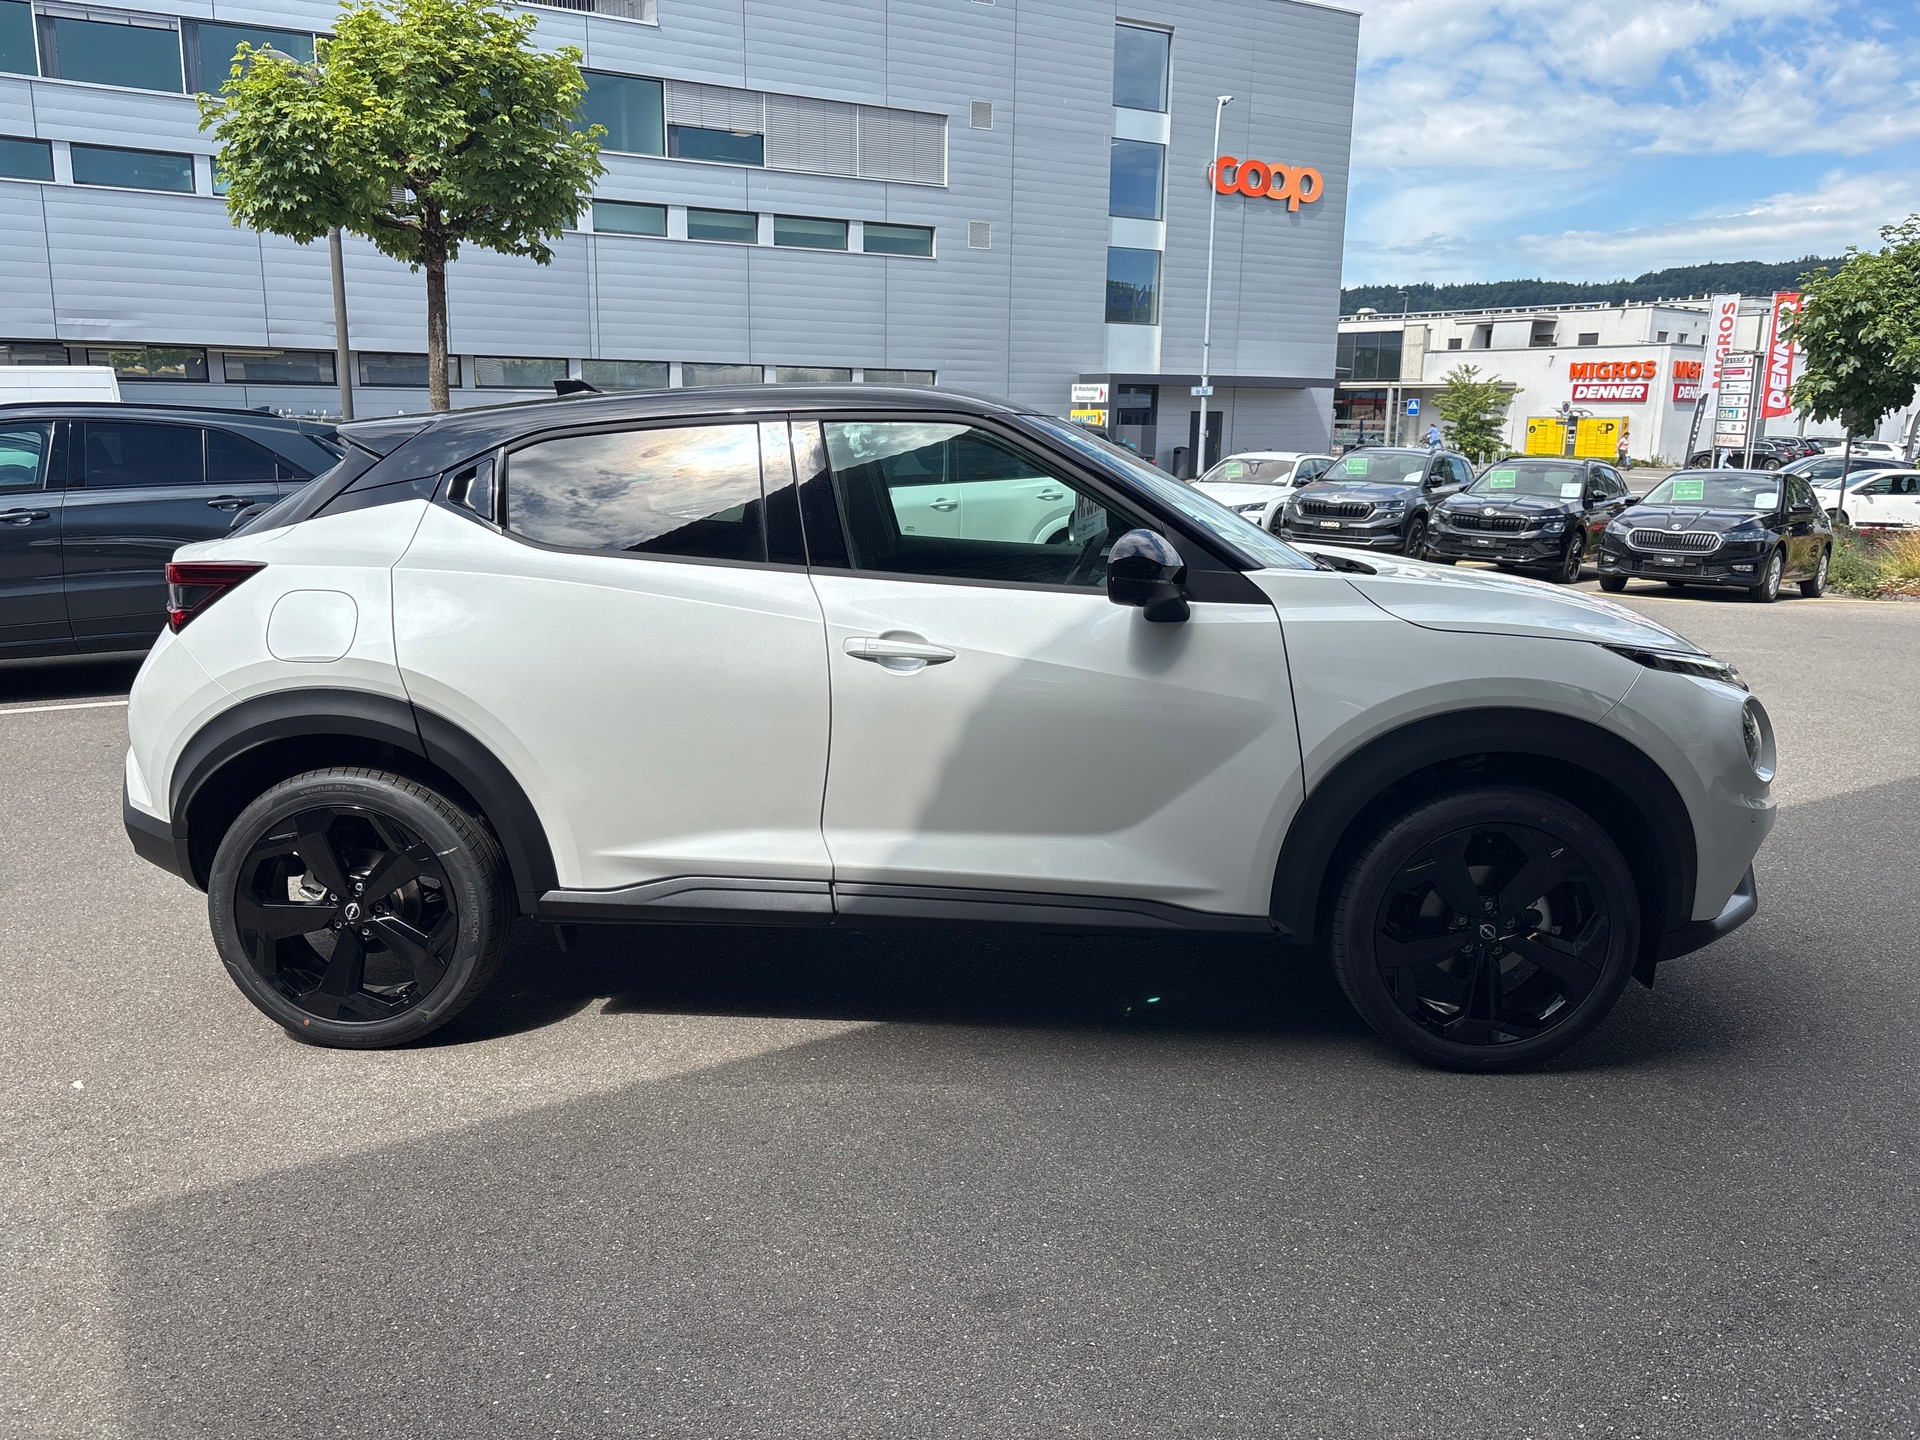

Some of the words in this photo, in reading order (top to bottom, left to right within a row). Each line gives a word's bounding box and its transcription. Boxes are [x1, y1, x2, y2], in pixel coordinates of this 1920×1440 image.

[1209, 156, 1324, 212] coop
[1569, 361, 1656, 380] MIGROS
[1574, 385, 1645, 399] DENNER
